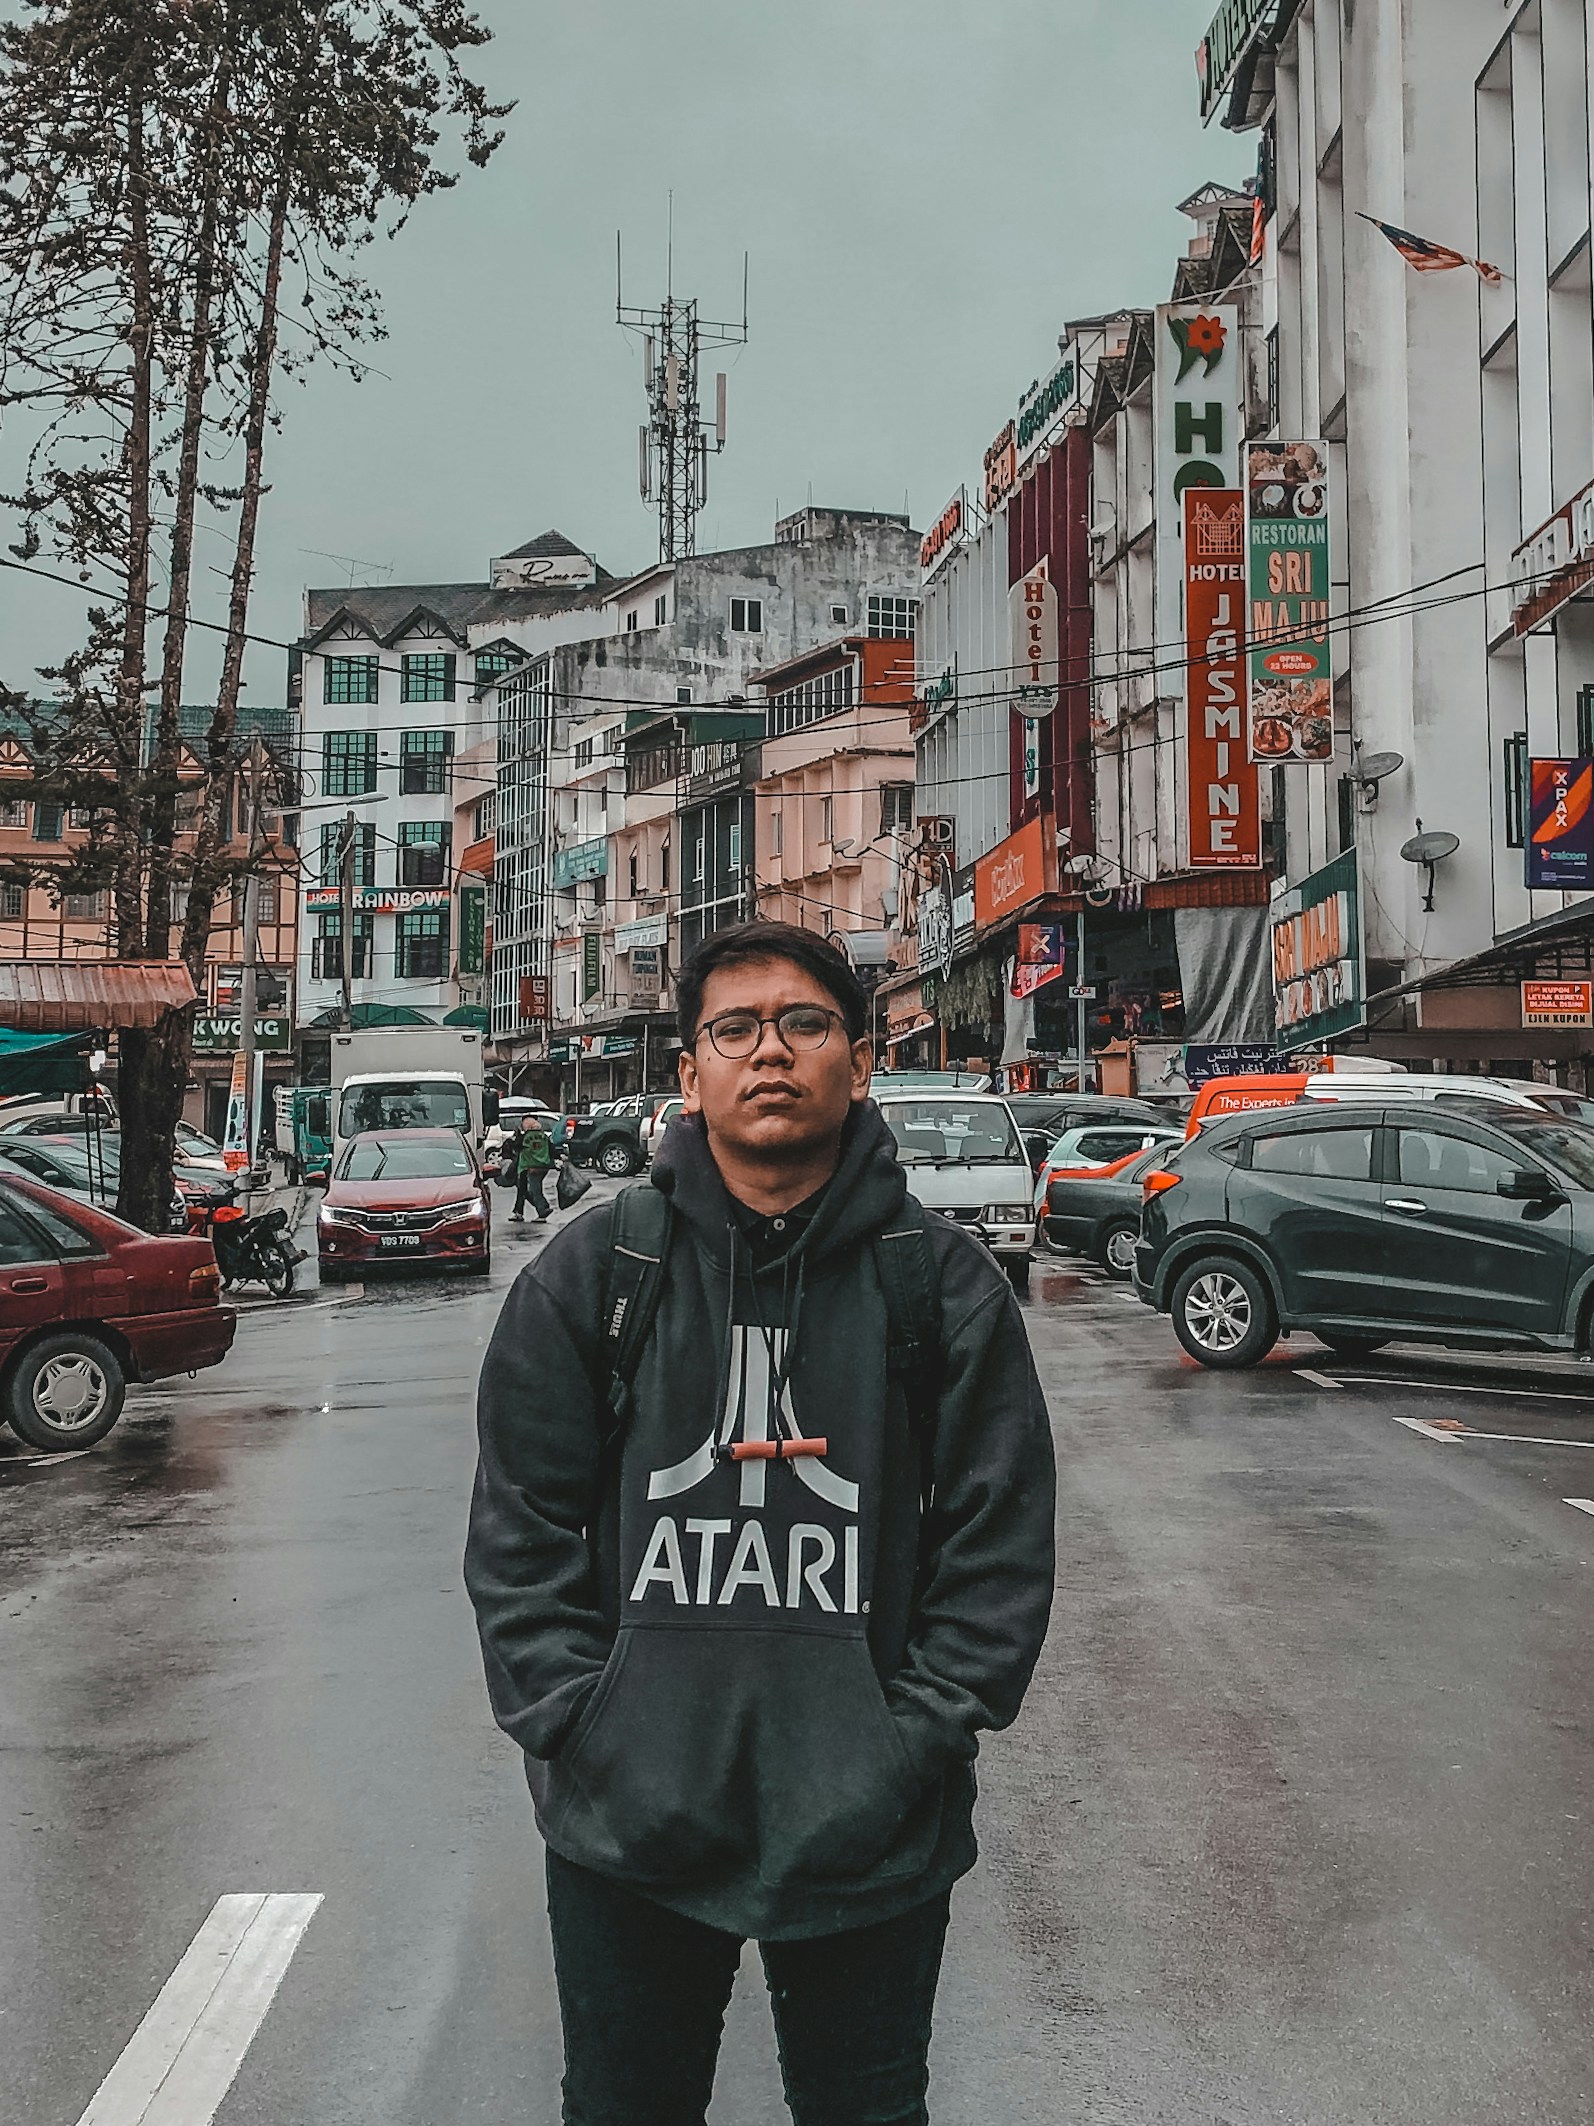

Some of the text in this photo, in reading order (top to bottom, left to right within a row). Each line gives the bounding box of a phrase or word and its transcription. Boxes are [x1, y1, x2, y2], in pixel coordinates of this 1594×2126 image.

[1252, 524, 1325, 545] RESTORAN
[1190, 564, 1246, 582] HOTEL
[1268, 551, 1312, 595] SRI
[1024, 582, 1044, 681] Hotel
[1253, 601, 1328, 645] MAJU
[1205, 594, 1240, 852] JASMINE
[707, 743, 722, 771] HIN
[1555, 771, 1568, 827] XPAX
[312, 891, 443, 909] HOTE RAINBOW
[1219, 1096, 1240, 1109] The
[608, 1297, 628, 1338] THULE
[629, 1515, 859, 1615] ATARI
